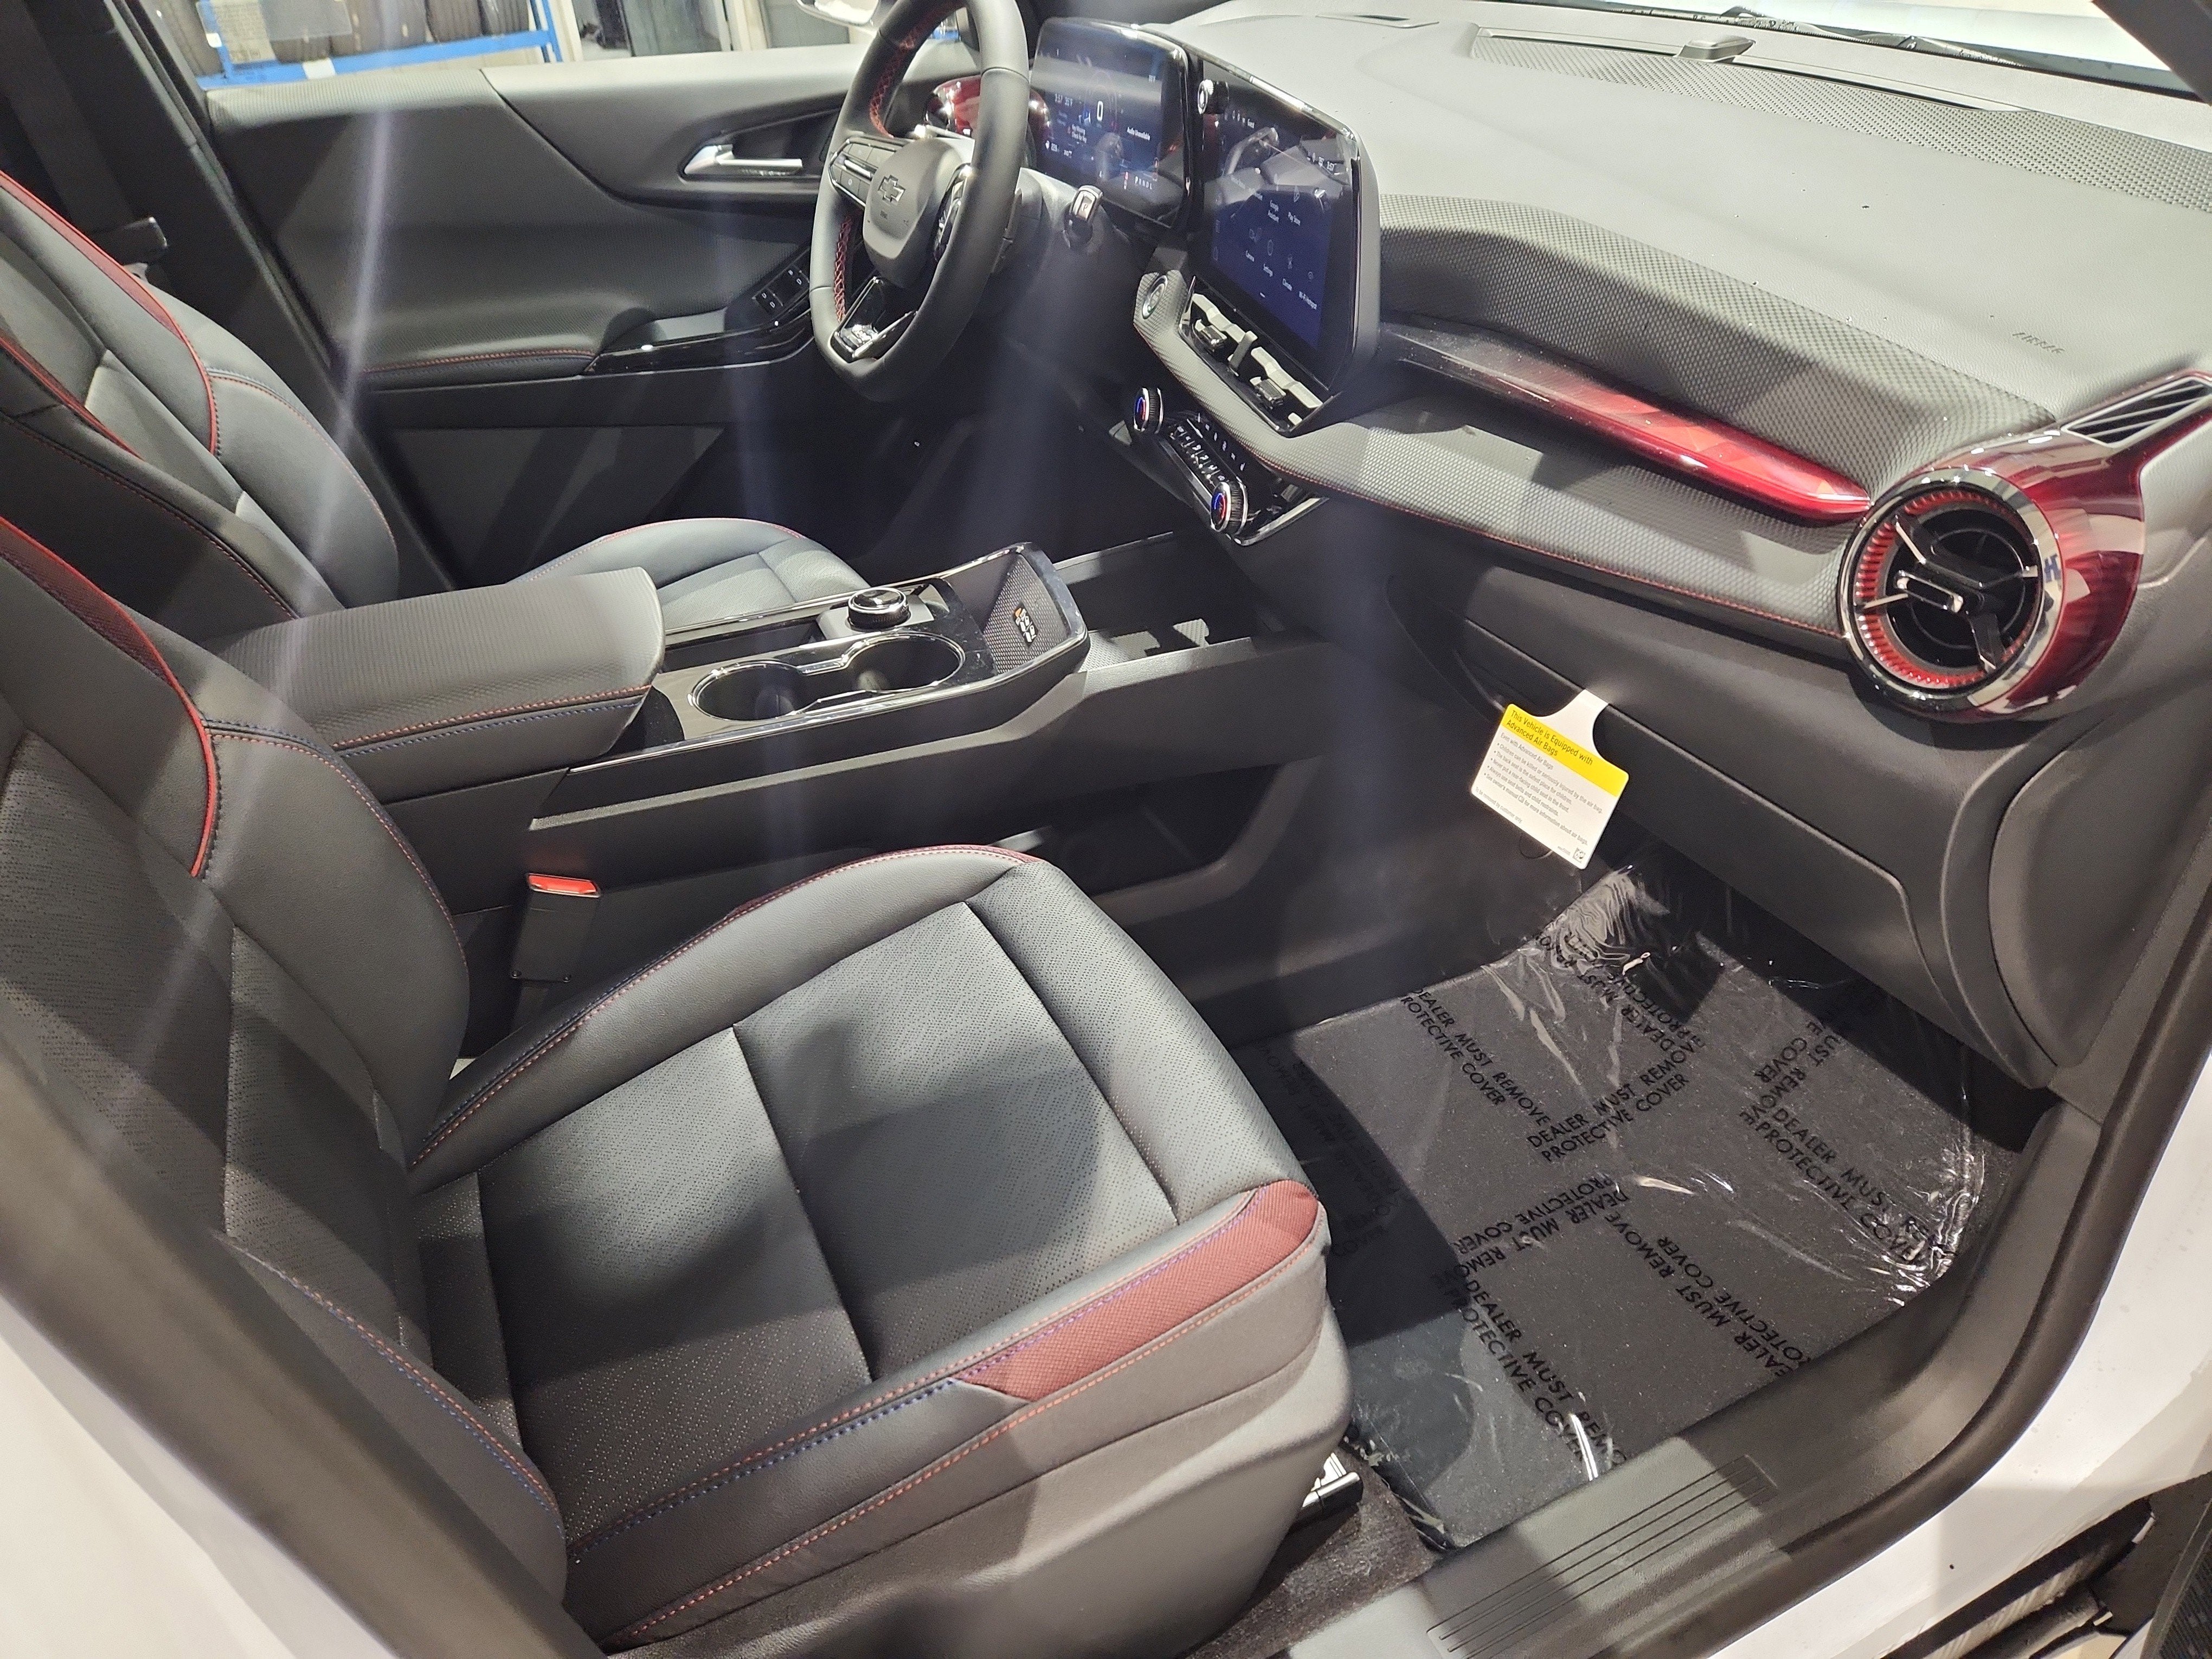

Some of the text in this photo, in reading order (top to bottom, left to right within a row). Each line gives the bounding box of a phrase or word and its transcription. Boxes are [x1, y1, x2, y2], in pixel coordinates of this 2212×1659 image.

[1096, 100, 1104, 122] 0
[1506, 719, 1558, 756] Advanced Air Bags
[1511, 709, 1592, 765] This Vehicle is Equipped with
[1400, 996, 1507, 1105] ROTECTIVE COVER
[1455, 1033, 1493, 1066] MUST
[1492, 1072, 1551, 1126] REMOVE
[1527, 1035, 1706, 1147] DEALER MUST REMOVE
[1754, 1037, 1807, 1083] COVER
[1808, 1035, 1841, 1067] UST
[1541, 1073, 1689, 1162] PROTECTIVE COVER
[1772, 1108, 1836, 1164] DEALER
[1565, 1189, 1630, 1225] DEALER
[1755, 1121, 1856, 1211] PROTECTIVE
[1452, 1173, 1616, 1255] PROTECTIVE COVER
[1604, 1211, 1793, 1377] EALER MUST REMOVE
[1657, 1236, 1809, 1364] OTECTIVE COVER
[1465, 1280, 1627, 1467] DEALER MUST REMO
